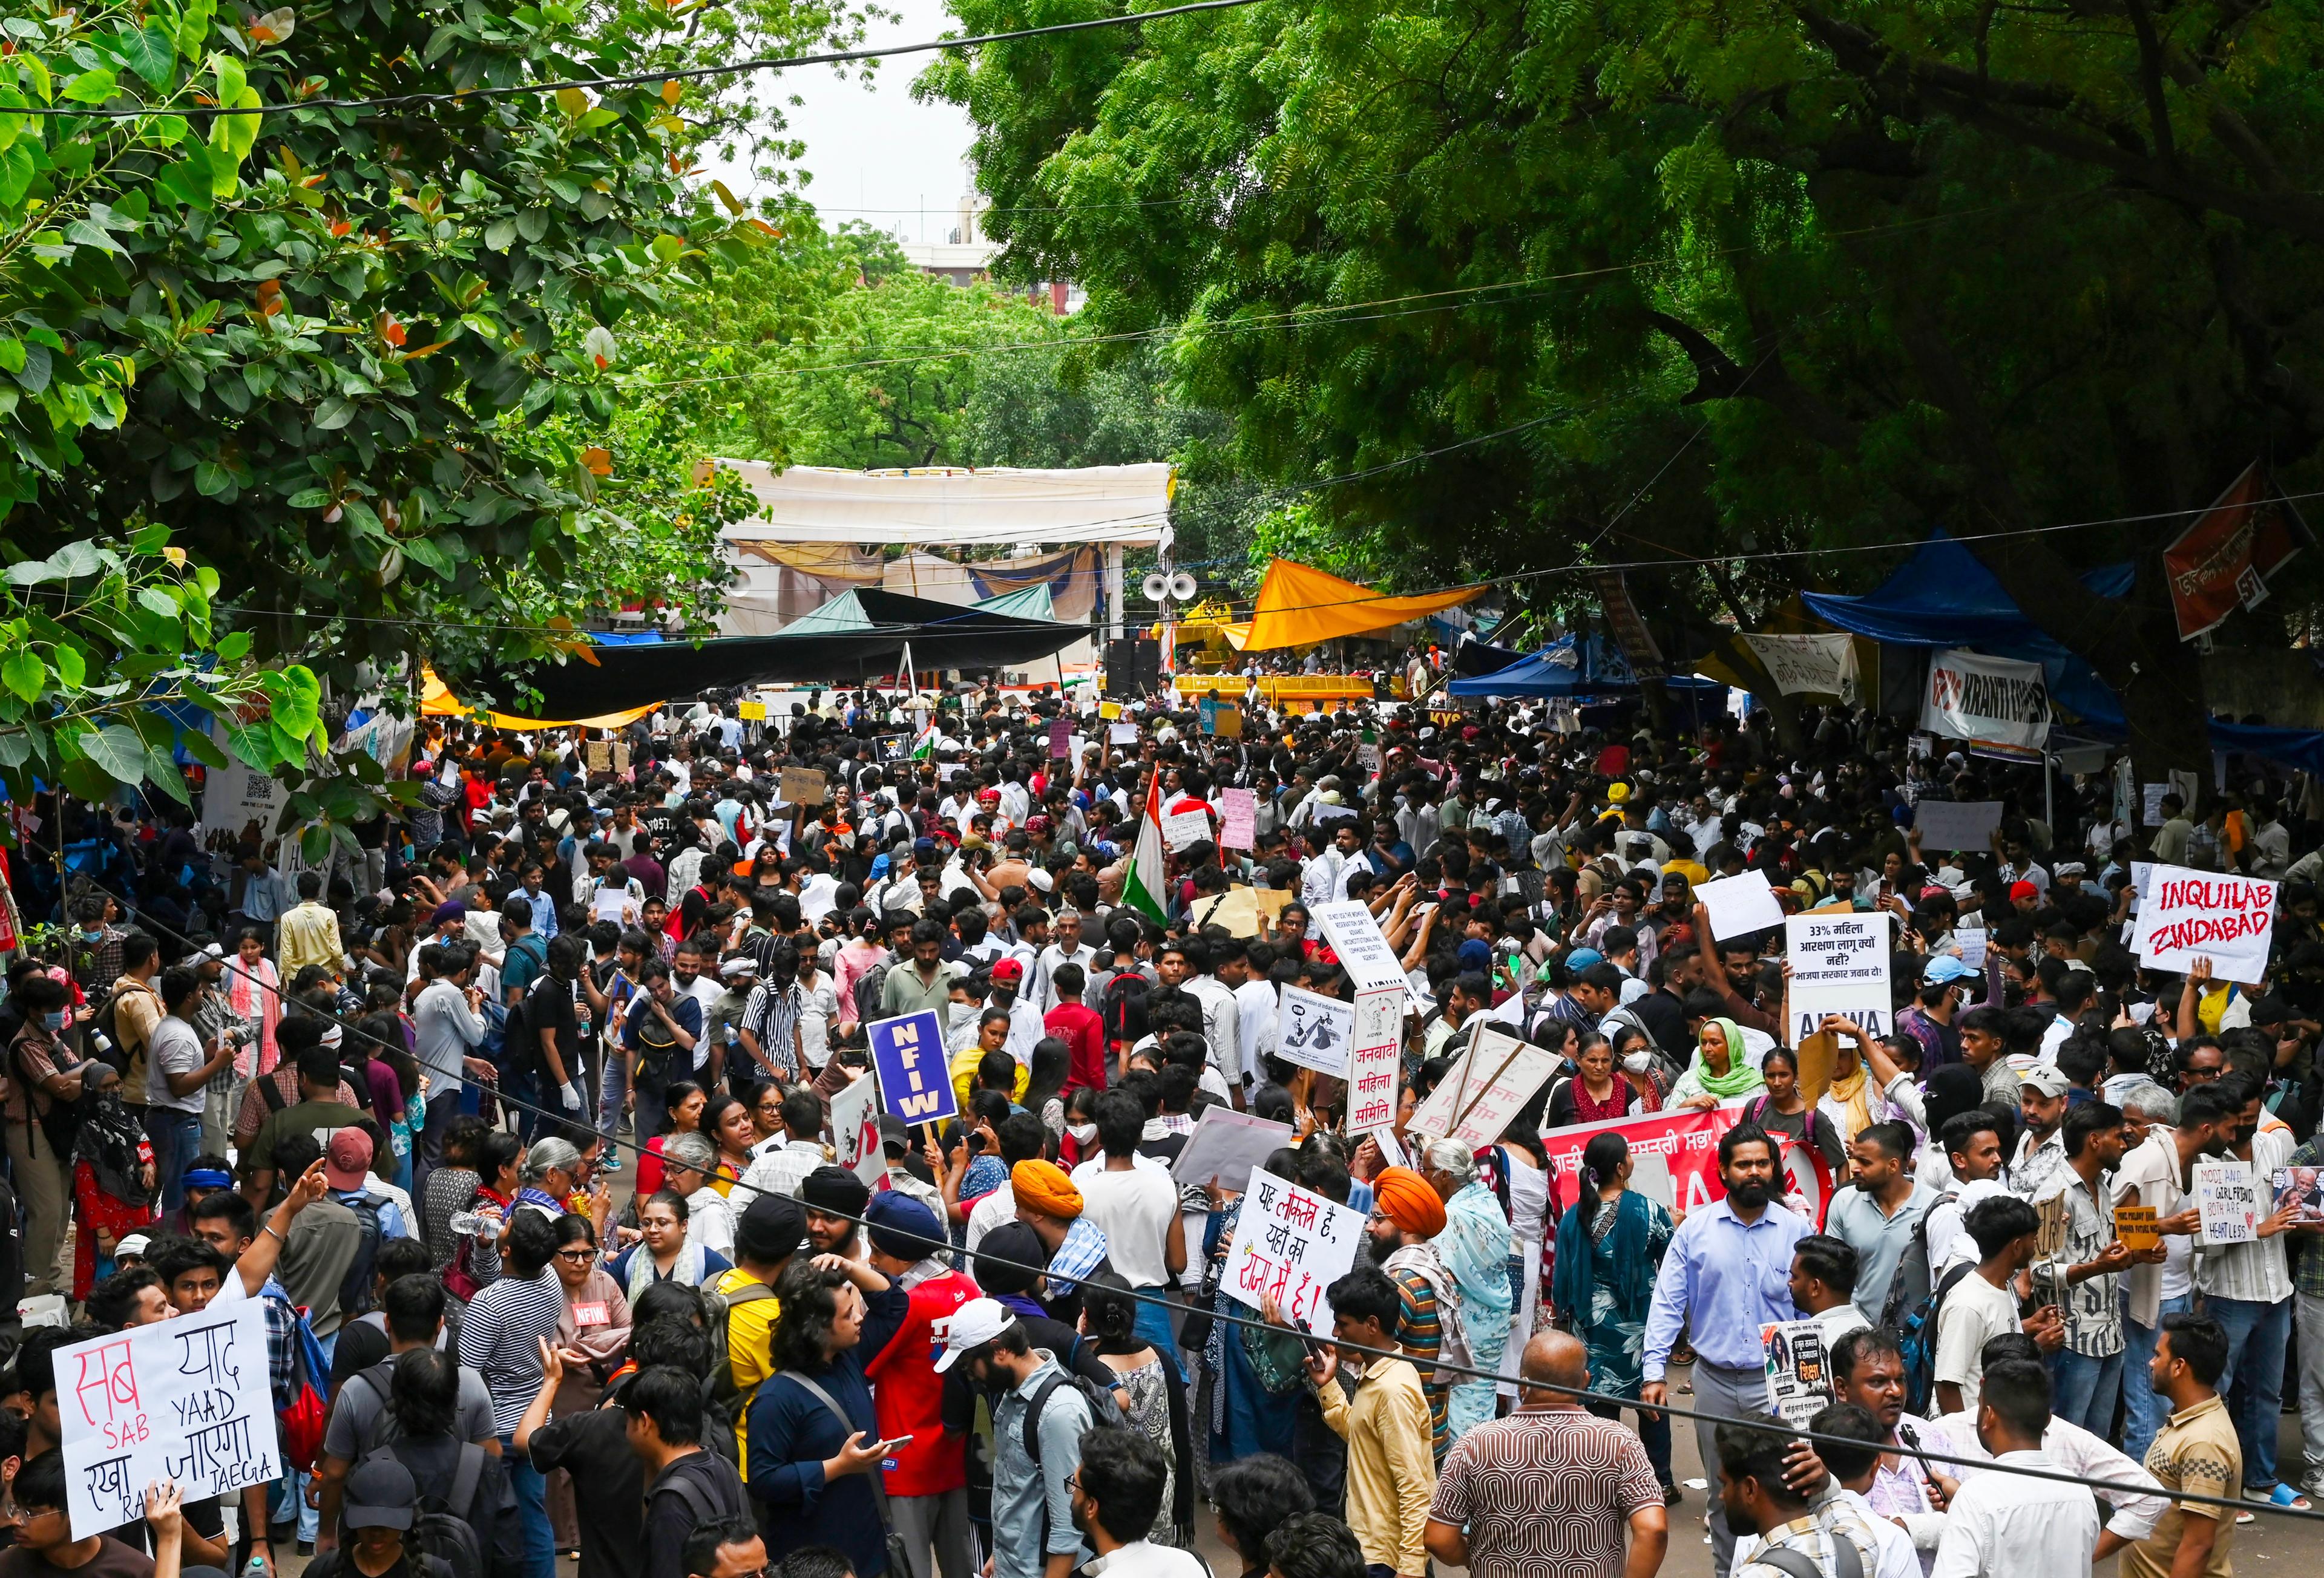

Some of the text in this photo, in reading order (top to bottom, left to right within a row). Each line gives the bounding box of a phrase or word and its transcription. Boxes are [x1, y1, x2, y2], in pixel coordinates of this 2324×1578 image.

[1959, 672, 2009, 721] KRANTI
[1430, 711, 1461, 728] KYS
[1361, 759, 1377, 770] aisa
[2159, 880, 2273, 911] INQUILAB
[1810, 922, 1863, 936] 33% महिला
[2149, 911, 2269, 955] ZINDABAD
[1342, 937, 1373, 946] UNCONSTITUTIONAL
[1800, 935, 1876, 953] आरक्षण लागू क्यों
[1826, 952, 1850, 966] नहीं?
[1796, 966, 1882, 980] भाजपा सरकार जवाब दो!
[1287, 992, 1299, 1001] National
[1300, 996, 1317, 1007] Federation
[1356, 1038, 1397, 1064] जनवादी
[891, 1022, 939, 1118] NFIW
[1358, 1072, 1391, 1094] महिला
[1355, 1099, 1389, 1124] समिति
[2201, 1169, 2241, 1184] MODI AND
[2216, 1187, 2253, 1203] GIRLFRIEND
[1259, 1182, 1336, 1244] यह लोकतंत्र है,
[2208, 1202, 2239, 1217] BOTH ARE
[1266, 1223, 1308, 1265] यहाँ का
[1239, 1252, 1272, 1296] राजा
[576, 1306, 605, 1323] NFIW
[73, 1319, 240, 1426] सब याद
[1799, 1361, 1820, 1381] शिक्षा
[103, 1387, 235, 1449] SAB YAAD
[84, 1414, 251, 1511] रखा जाएगा
[209, 1452, 272, 1495] JAEGA
